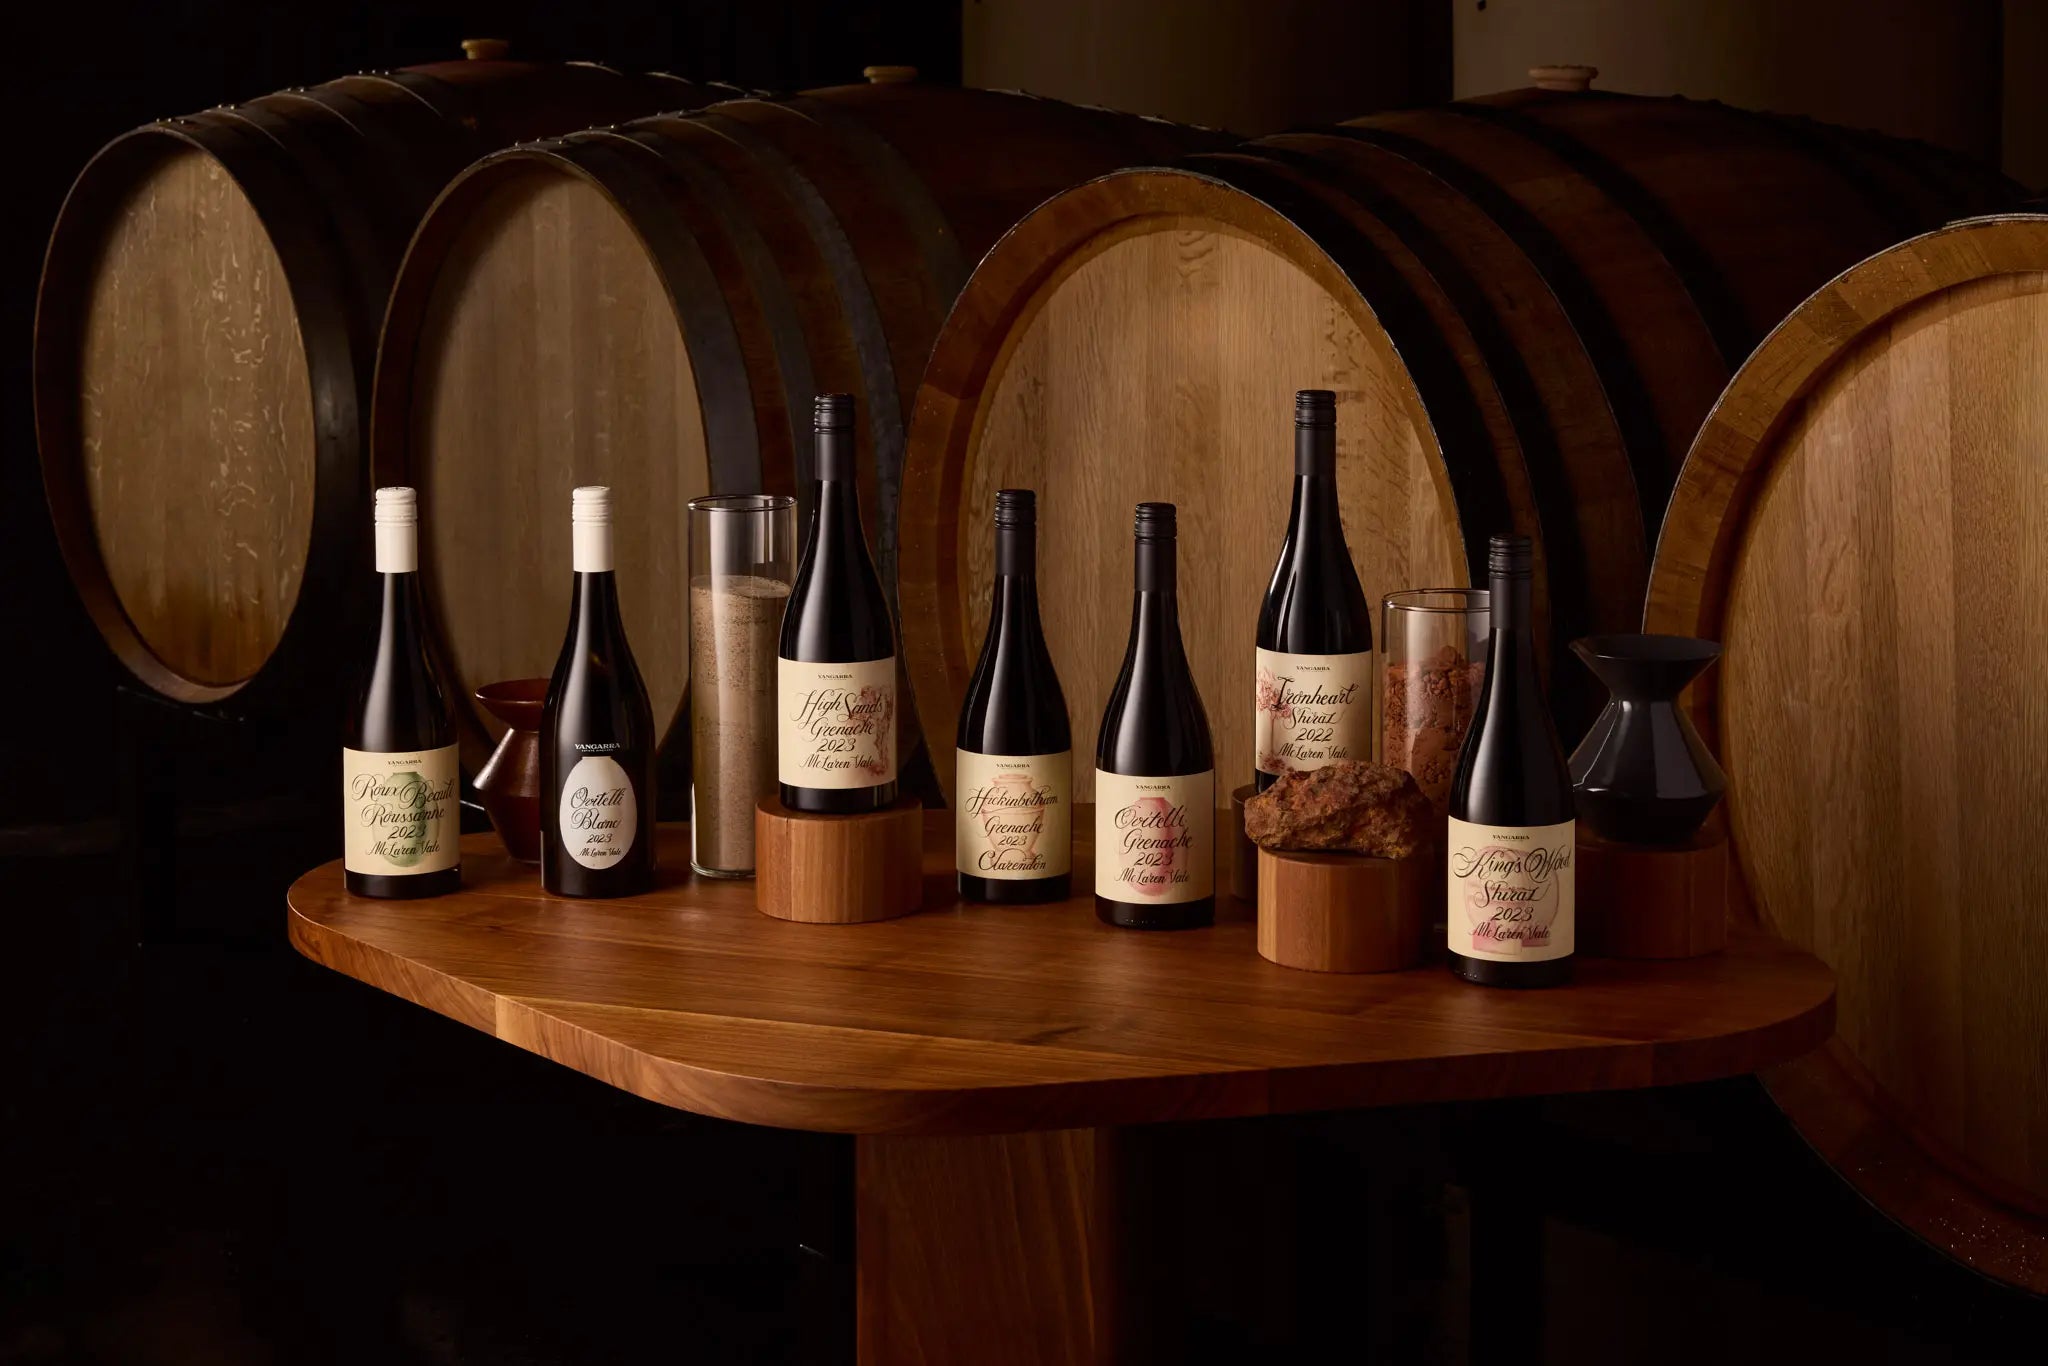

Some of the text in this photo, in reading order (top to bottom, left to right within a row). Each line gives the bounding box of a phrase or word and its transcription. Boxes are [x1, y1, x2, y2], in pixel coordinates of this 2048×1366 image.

[1271, 676, 1360, 711] Ironheart
[790, 689, 884, 729] High Sands
[1283, 706, 1345, 730] Shiraz
[803, 717, 875, 742] Grenache
[1294, 728, 1334, 743] 2022
[574, 742, 621, 750] YANGARRA
[816, 738, 856, 753] 2023
[1279, 743, 1348, 761] McLaren Vale
[799, 754, 875, 771] McLaren Vale
[352, 773, 400, 802] Roux
[965, 784, 1058, 819] Hickinbotham
[361, 803, 445, 828] Roussanne
[571, 807, 622, 830] Blanc
[979, 815, 1045, 838] Grenache
[1114, 804, 1188, 829] Ovitelli
[387, 824, 427, 840] 2023
[586, 833, 613, 844] 2023
[997, 835, 1028, 847] 2023
[1117, 827, 1194, 855] Grenache
[366, 840, 440, 858] McLaren Vale
[978, 847, 1047, 871] Clarendon
[1133, 851, 1174, 867] 2023
[1452, 844, 1572, 884] King's Wood
[1114, 867, 1190, 885] McLaren Vale
[1474, 880, 1552, 908] Shiraz
[1490, 906, 1534, 923] 2023
[1468, 921, 1550, 942] McLaren Vale
